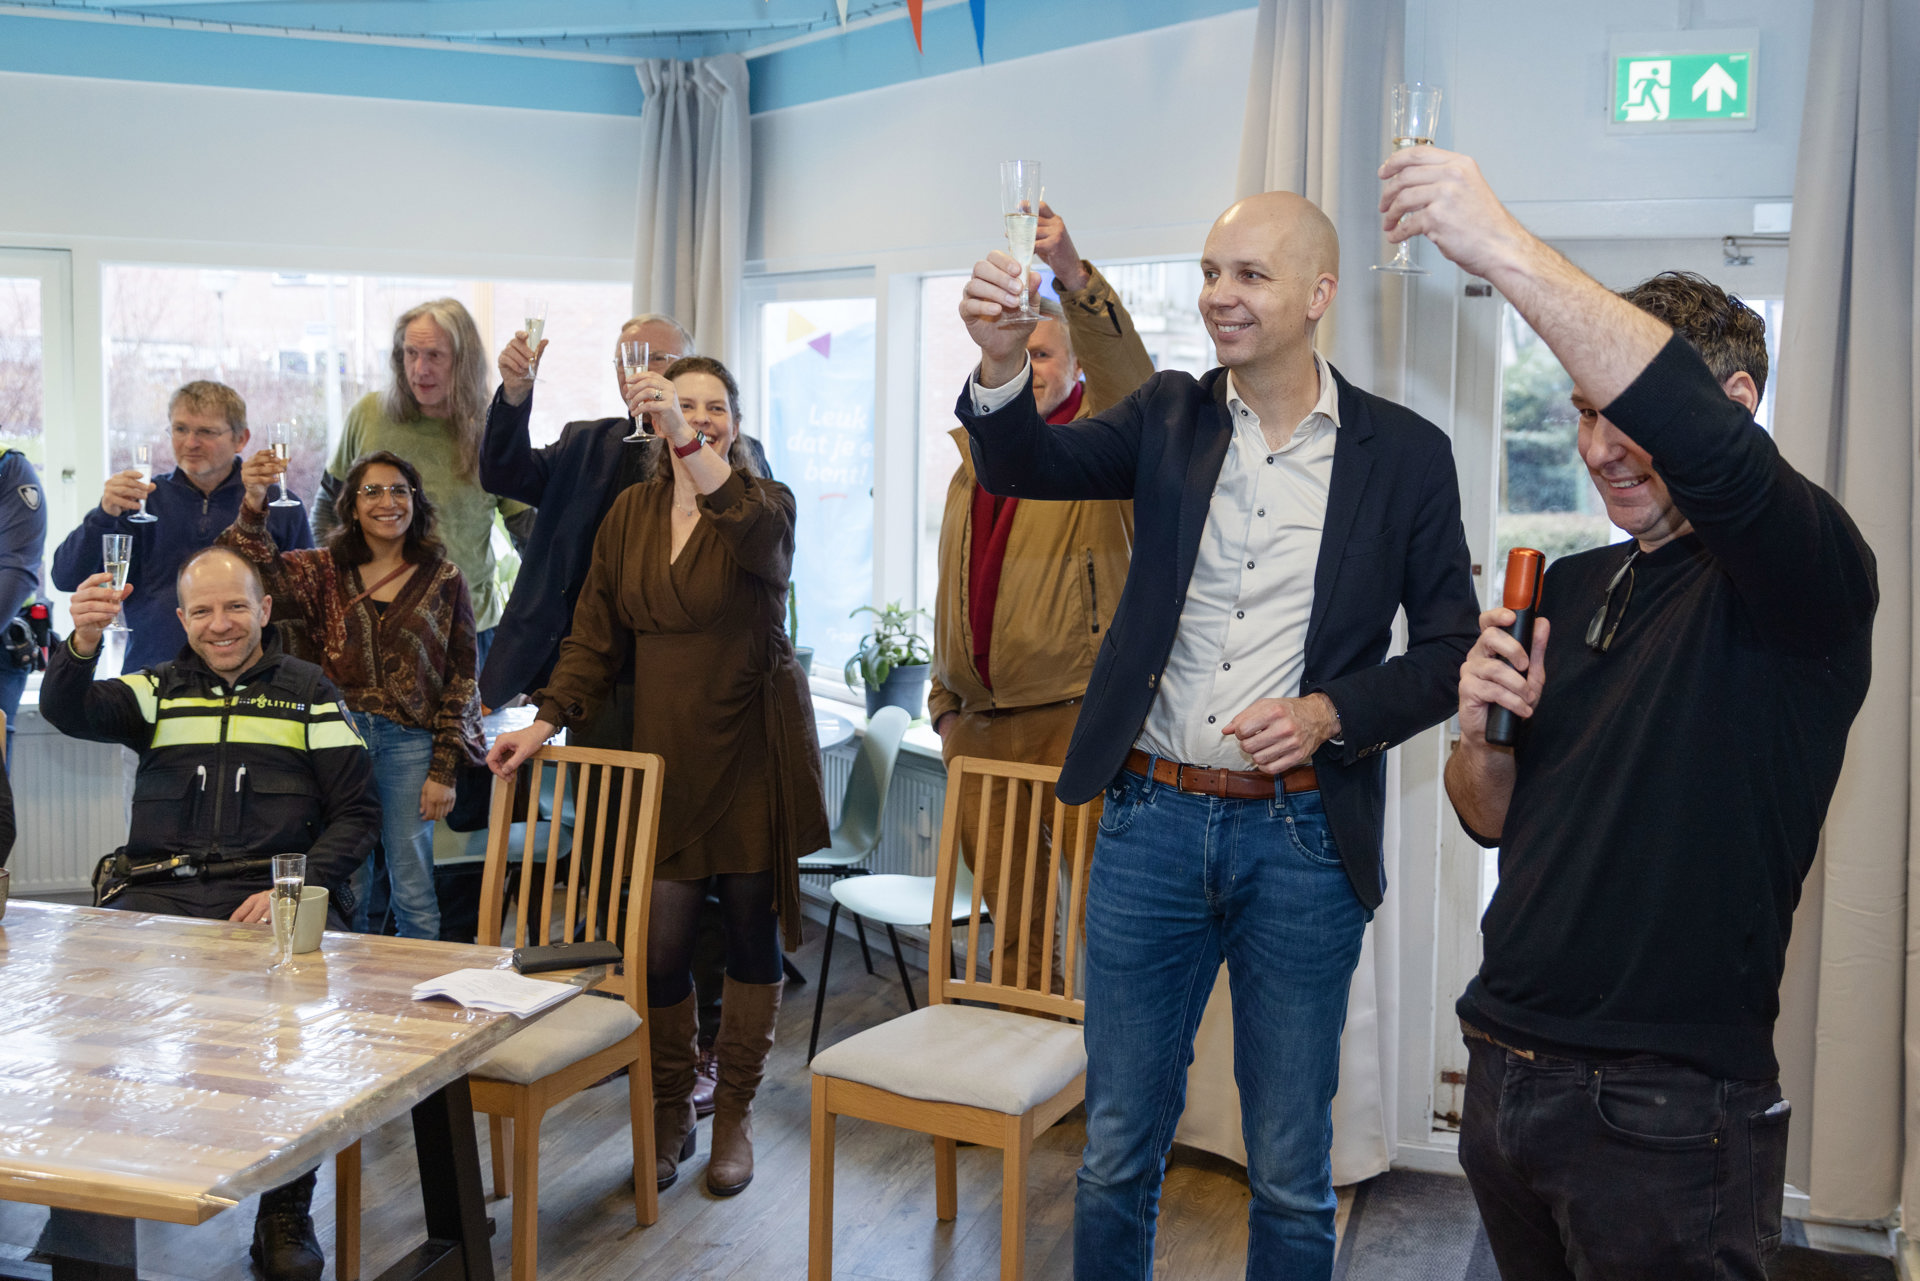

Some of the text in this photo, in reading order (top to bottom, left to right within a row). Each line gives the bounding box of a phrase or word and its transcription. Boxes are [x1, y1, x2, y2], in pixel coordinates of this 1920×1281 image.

[809, 404, 867, 429] Leuk
[786, 428, 827, 454] dat
[829, 433, 856, 463] je
[804, 456, 868, 485] bent!
[250, 694, 297, 709] POLITIE
